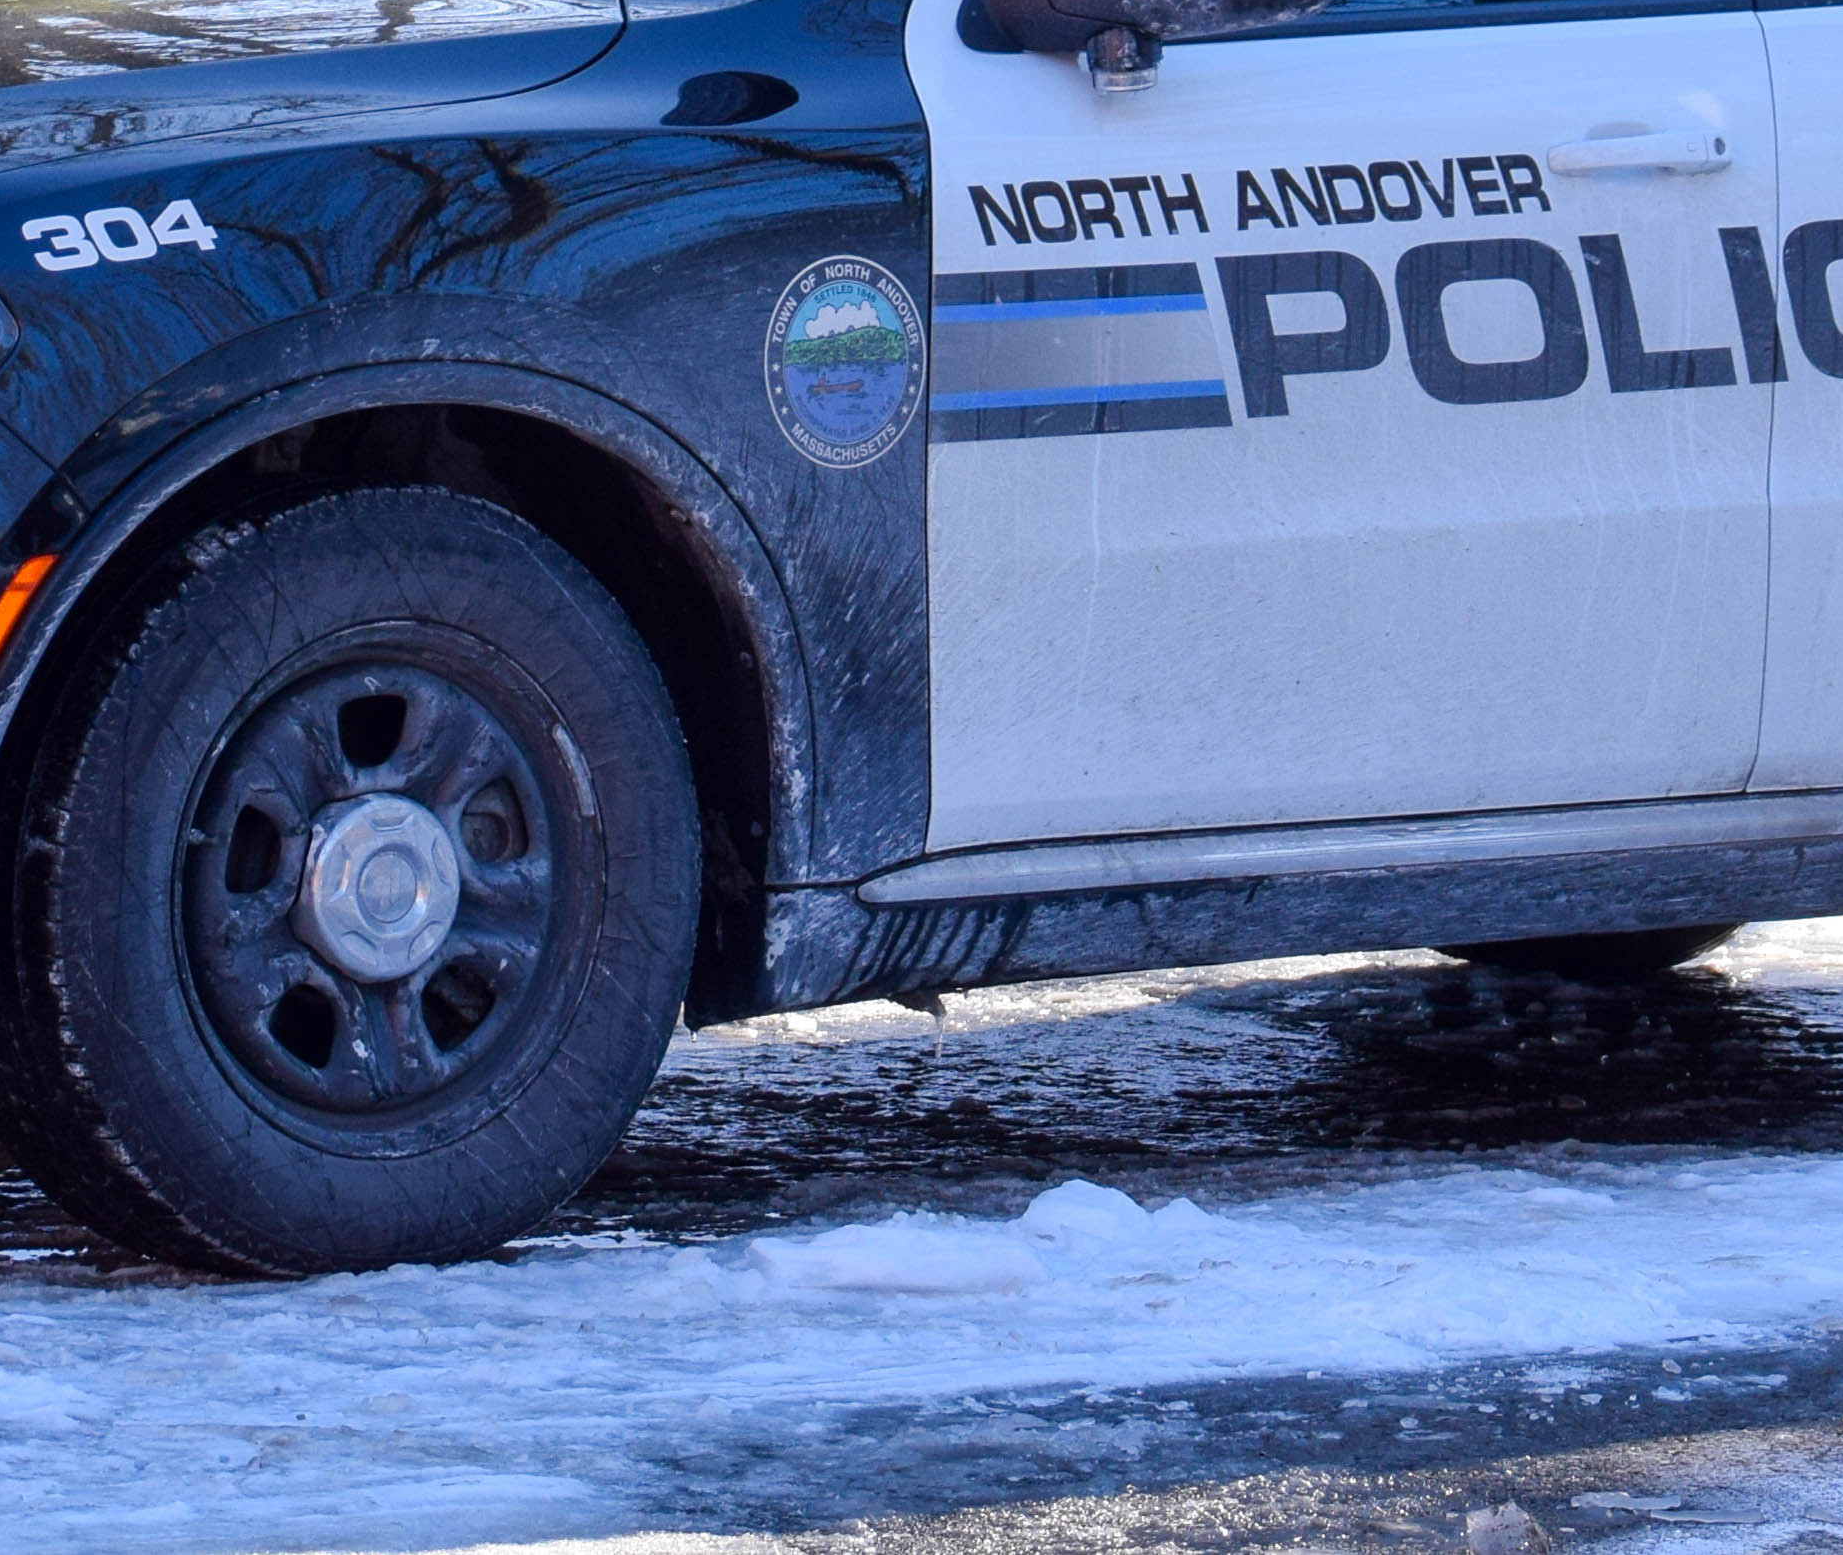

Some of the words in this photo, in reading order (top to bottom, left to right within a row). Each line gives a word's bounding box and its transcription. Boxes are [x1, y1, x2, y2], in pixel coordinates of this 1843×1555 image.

[21, 199, 217, 272] 304
[968, 171, 1211, 246] NORTH
[1234, 153, 1552, 234] ANDOVER
[772, 296, 798, 343] TOWN
[799, 273, 817, 294] OF
[824, 263, 871, 282] NORTH
[877, 277, 919, 346] ANDOVER
[791, 422, 897, 462] MASSACHUSETTS
